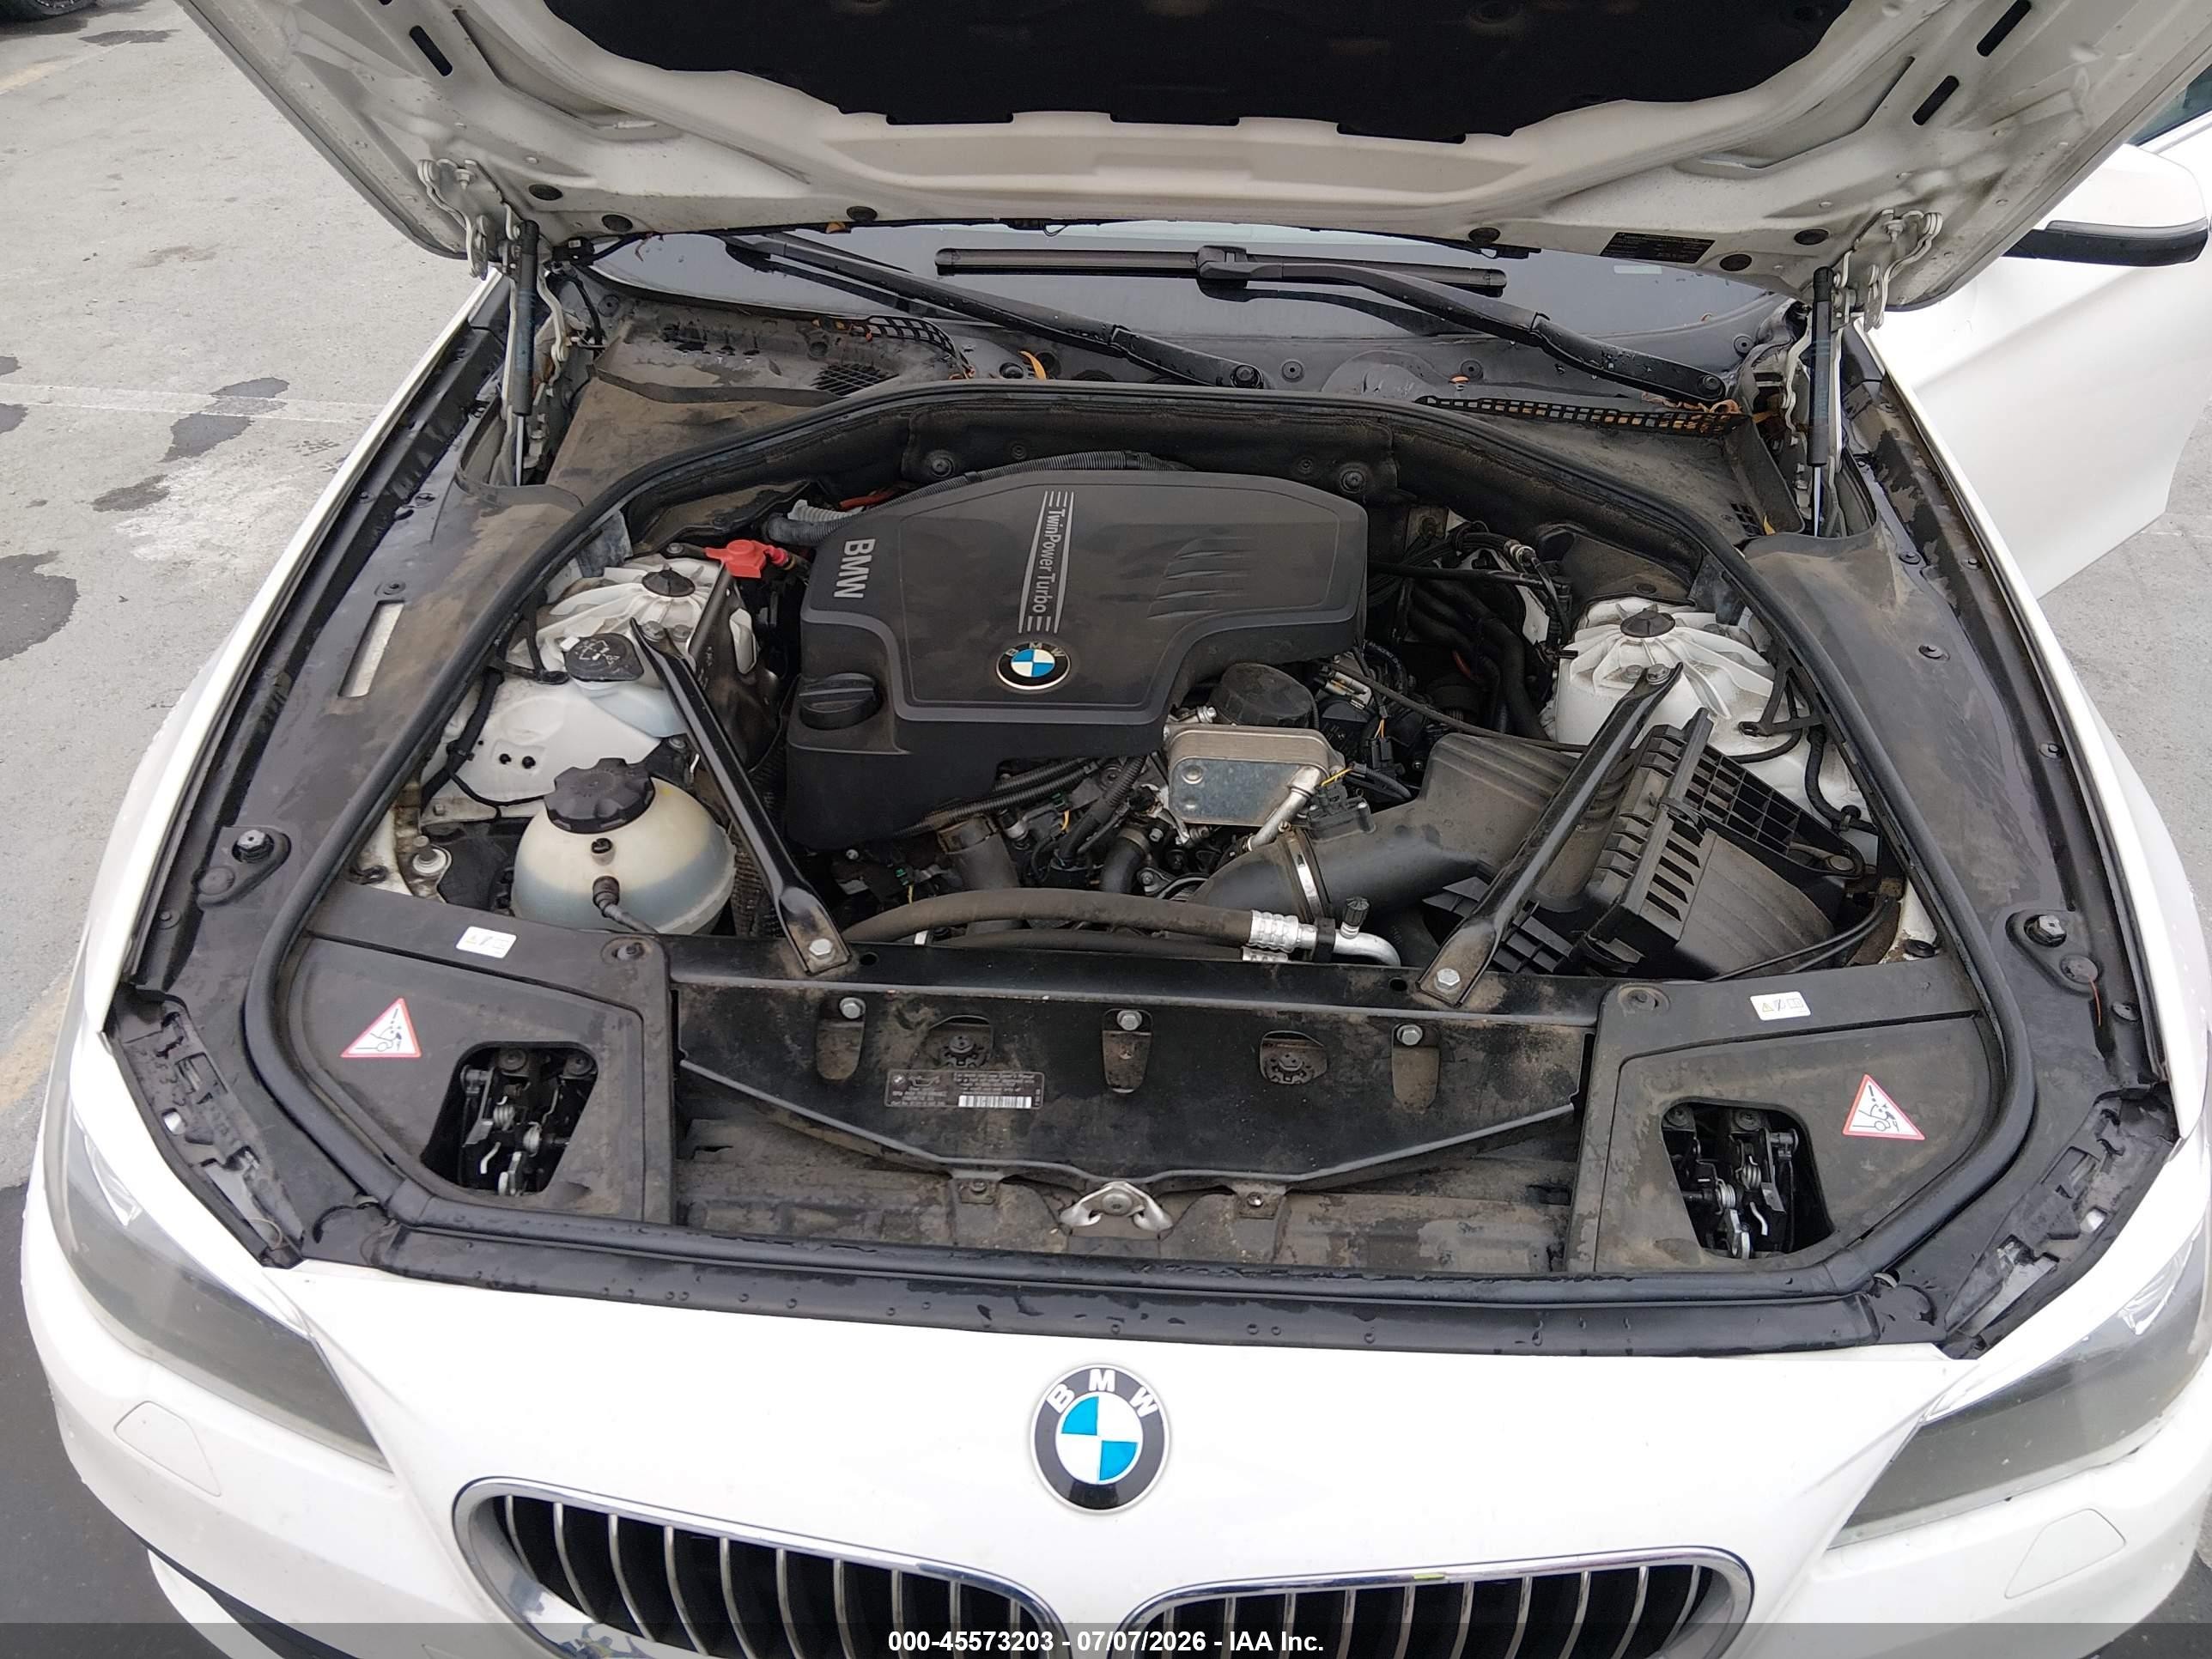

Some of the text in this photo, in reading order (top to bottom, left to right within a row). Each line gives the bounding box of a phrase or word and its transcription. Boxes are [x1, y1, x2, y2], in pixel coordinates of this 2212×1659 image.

[833, 538, 876, 599] BMW
[1032, 508, 1066, 613] TwinPower Turbo
[1005, 641, 1066, 657] BMW
[1046, 1368, 1159, 1418] BMW
